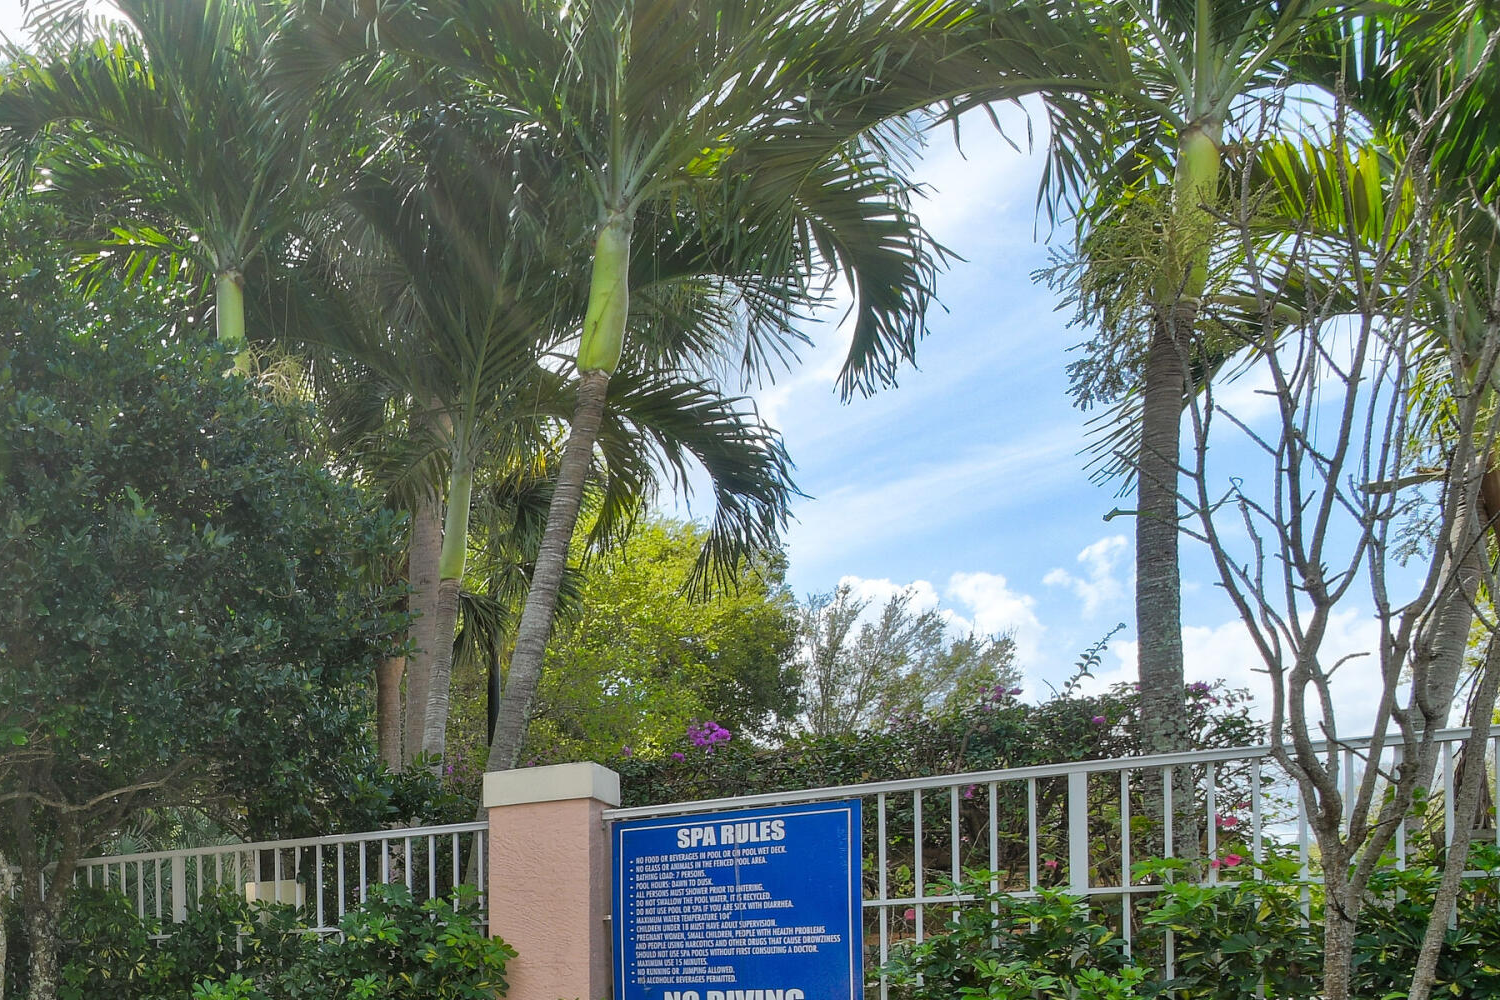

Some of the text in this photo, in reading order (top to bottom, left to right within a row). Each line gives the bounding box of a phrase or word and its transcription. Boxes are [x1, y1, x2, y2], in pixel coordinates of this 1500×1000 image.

[677, 819, 786, 849] SPA RULES
[669, 853, 698, 861] BEVERAGES
[670, 862, 693, 870] ANIMALS
[714, 859, 733, 867] FENCED
[735, 858, 750, 866] POOL
[657, 898, 682, 906] SWALLOW
[681, 913, 717, 922] TEMPERATURE
[721, 920, 738, 928] ADULT
[795, 926, 825, 934] PROBLEMS
